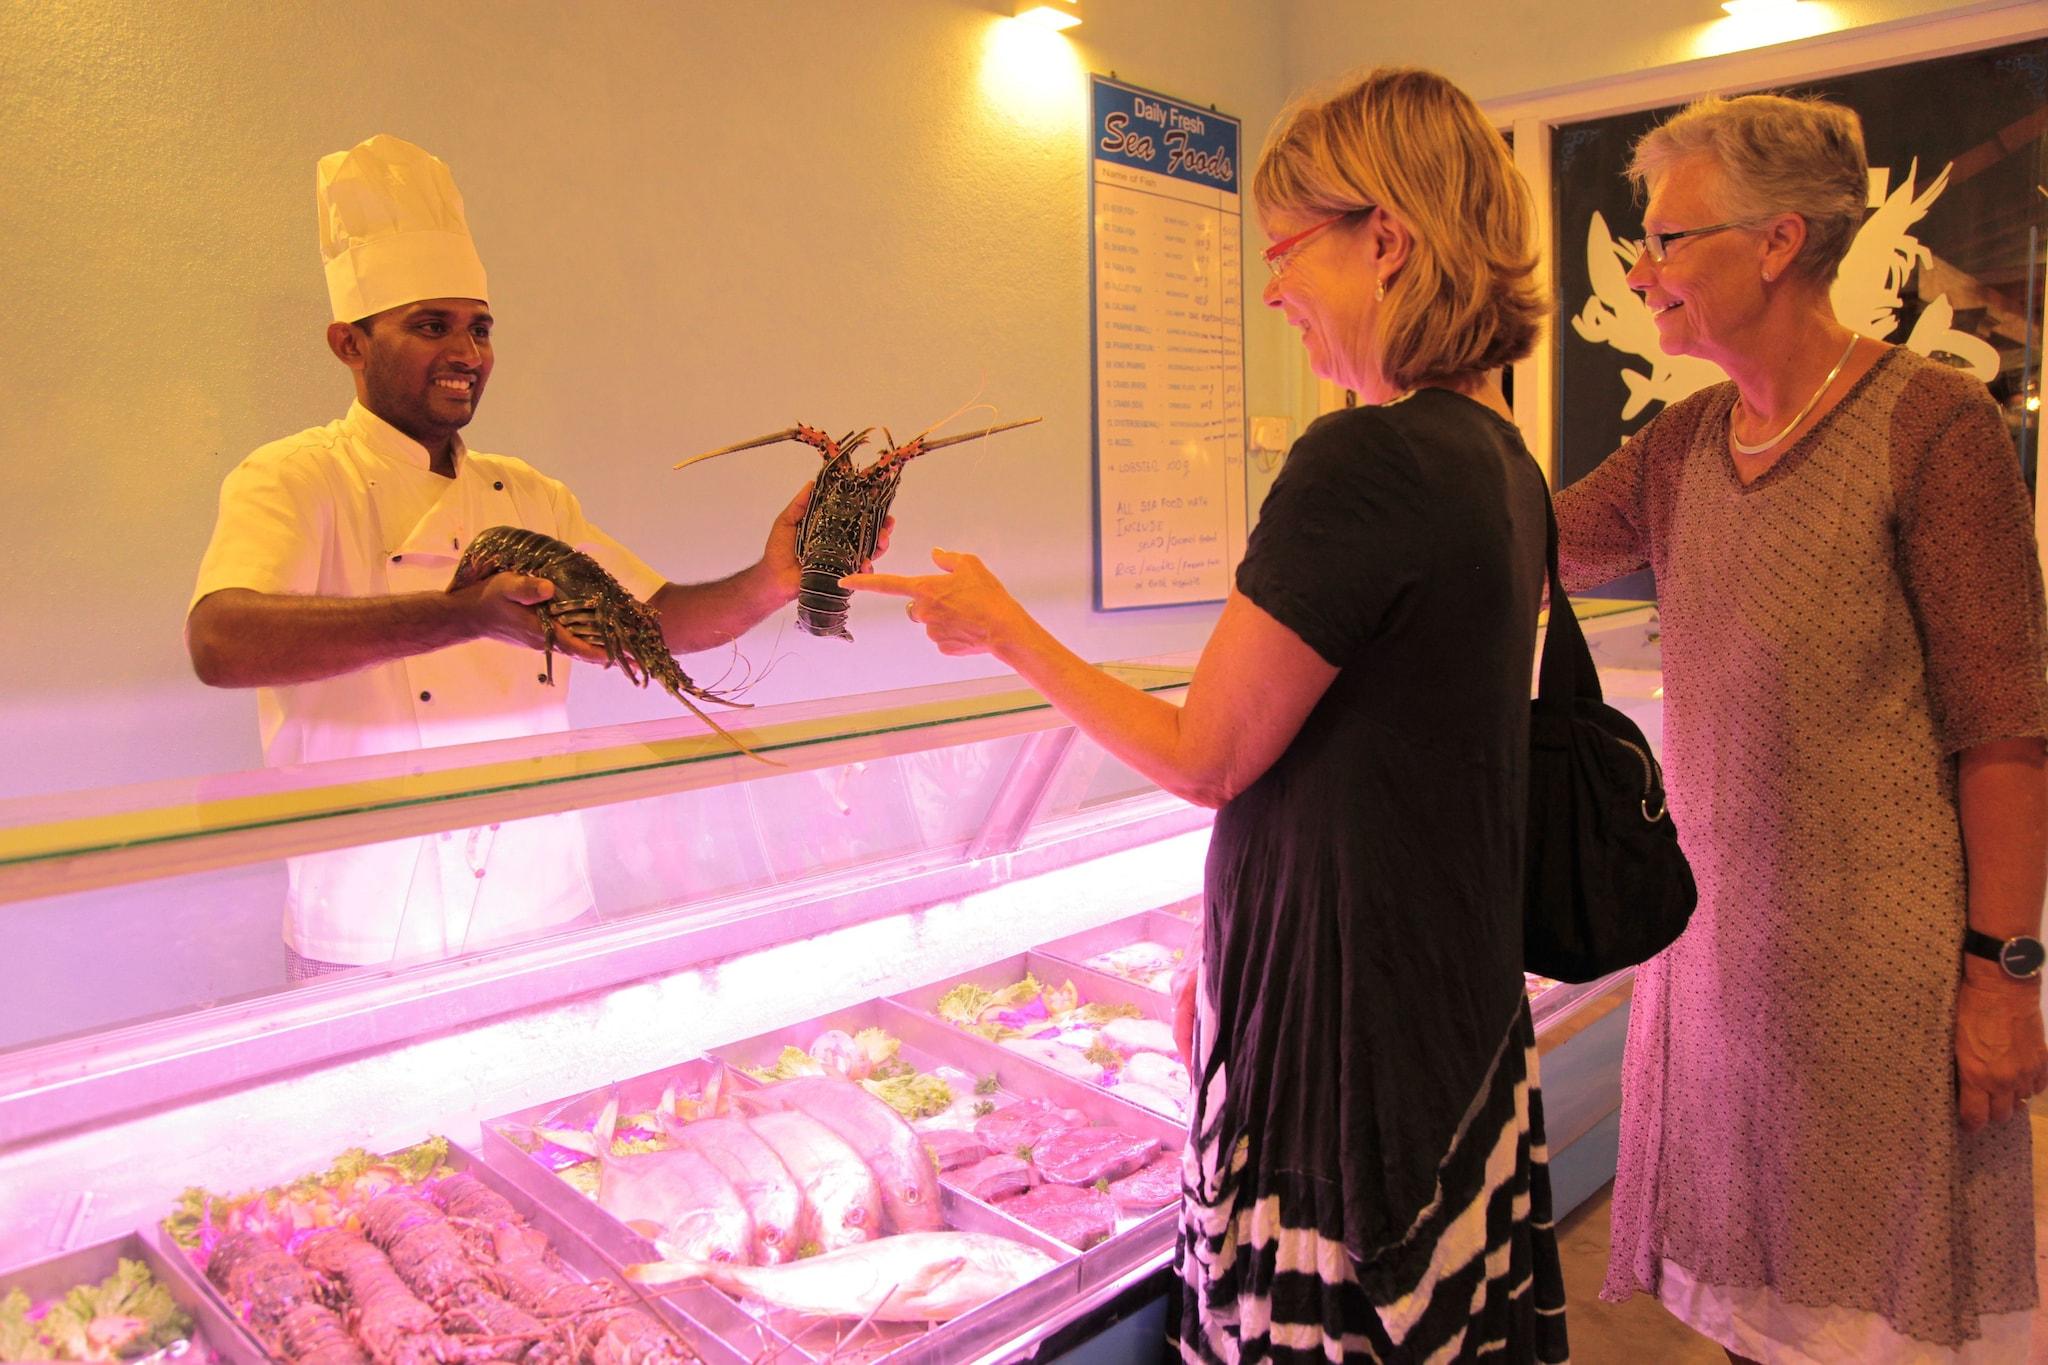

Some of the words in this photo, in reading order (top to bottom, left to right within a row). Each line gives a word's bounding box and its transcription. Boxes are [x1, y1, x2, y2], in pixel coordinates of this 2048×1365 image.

[1134, 97, 1167, 127] Daily
[1170, 107, 1205, 136] Fresh
[1101, 111, 1156, 161] Sea
[1164, 129, 1233, 182] Foods
[1102, 167, 1129, 183] Name
[1130, 173, 1139, 184] of
[1140, 176, 1158, 188] Fish
[1116, 501, 1135, 516] ALL
[1161, 497, 1183, 509] FOOD
